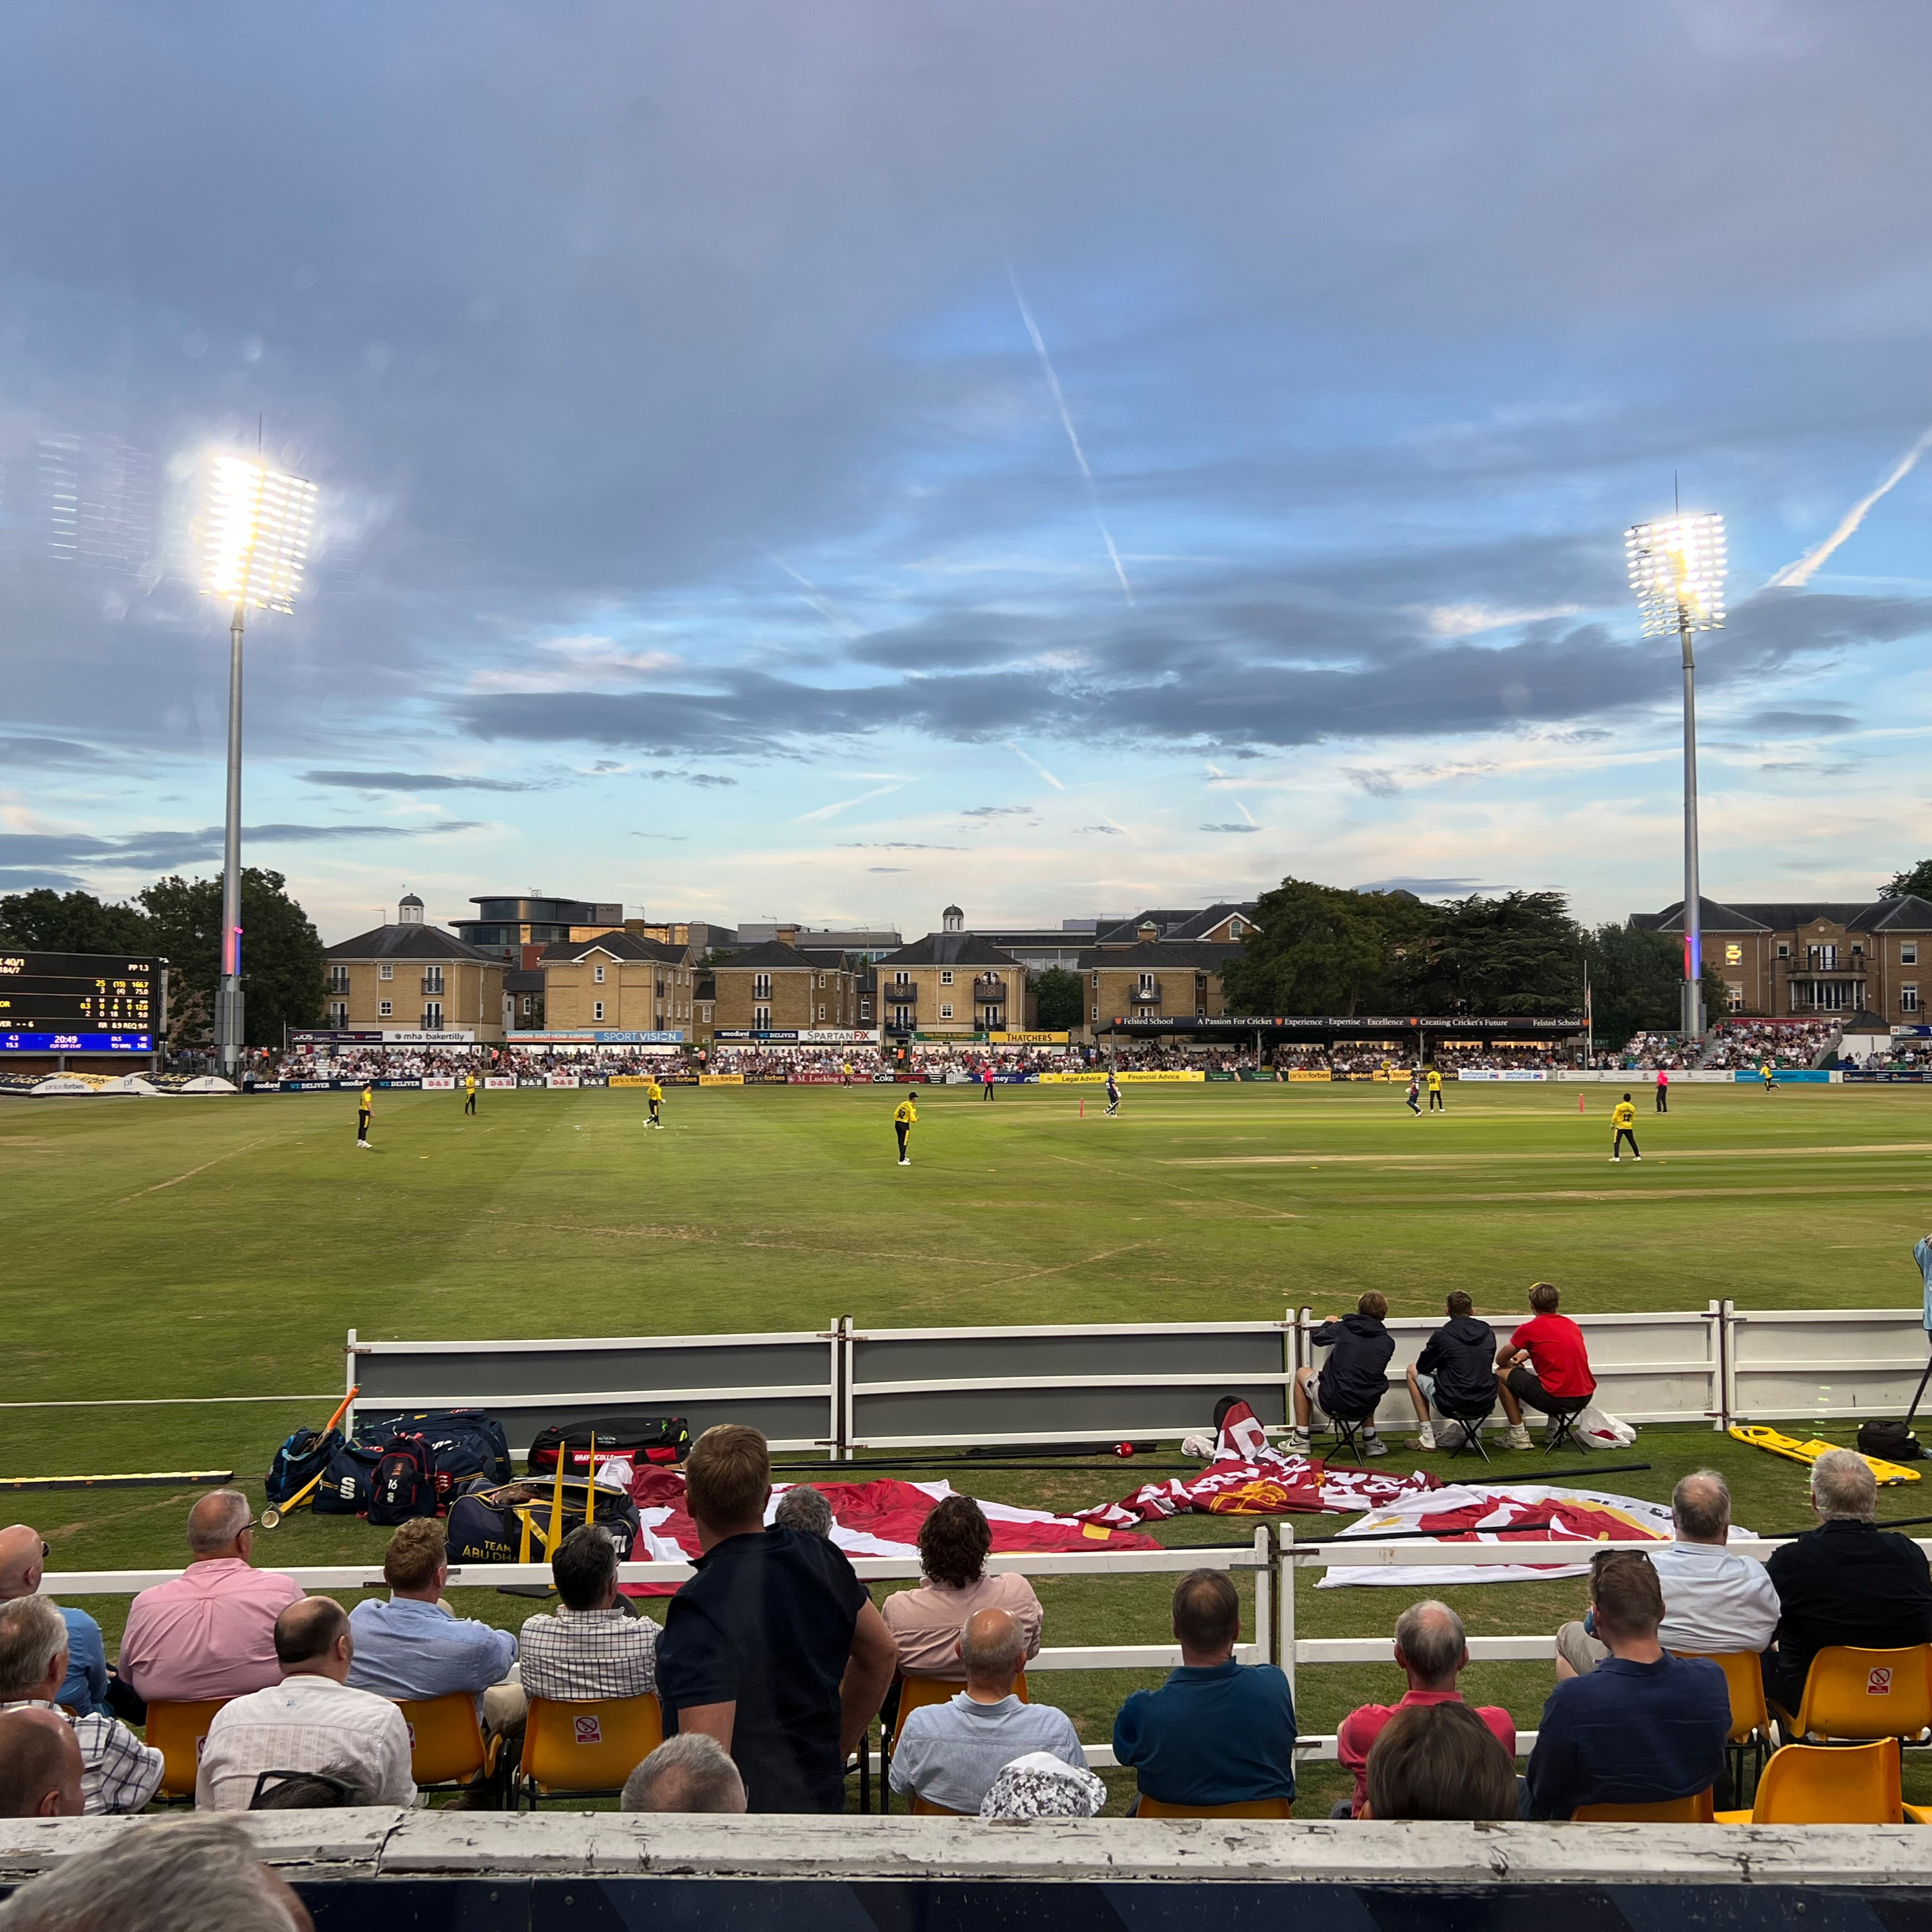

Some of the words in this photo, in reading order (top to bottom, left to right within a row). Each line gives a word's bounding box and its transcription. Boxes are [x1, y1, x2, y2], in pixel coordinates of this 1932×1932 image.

[4, 958, 24, 967] 40/1
[426, 1032, 465, 1041] bakertilly
[603, 1032, 637, 1041] SPORT
[639, 1032, 676, 1041] VISION
[1007, 1033, 1052, 1042] THATCHERS
[124, 1077, 133, 1087] pf
[205, 1077, 214, 1086] pf
[701, 1075, 741, 1084] priceforbes
[810, 1074, 839, 1084] Lucking
[873, 1074, 894, 1082] Coke
[896, 1075, 925, 1083] Gearing
[980, 1075, 1009, 1083] Tmey
[388, 1479, 397, 1490] 16
[462, 1544, 489, 1558] ABU
[484, 1540, 511, 1553] TEAM
